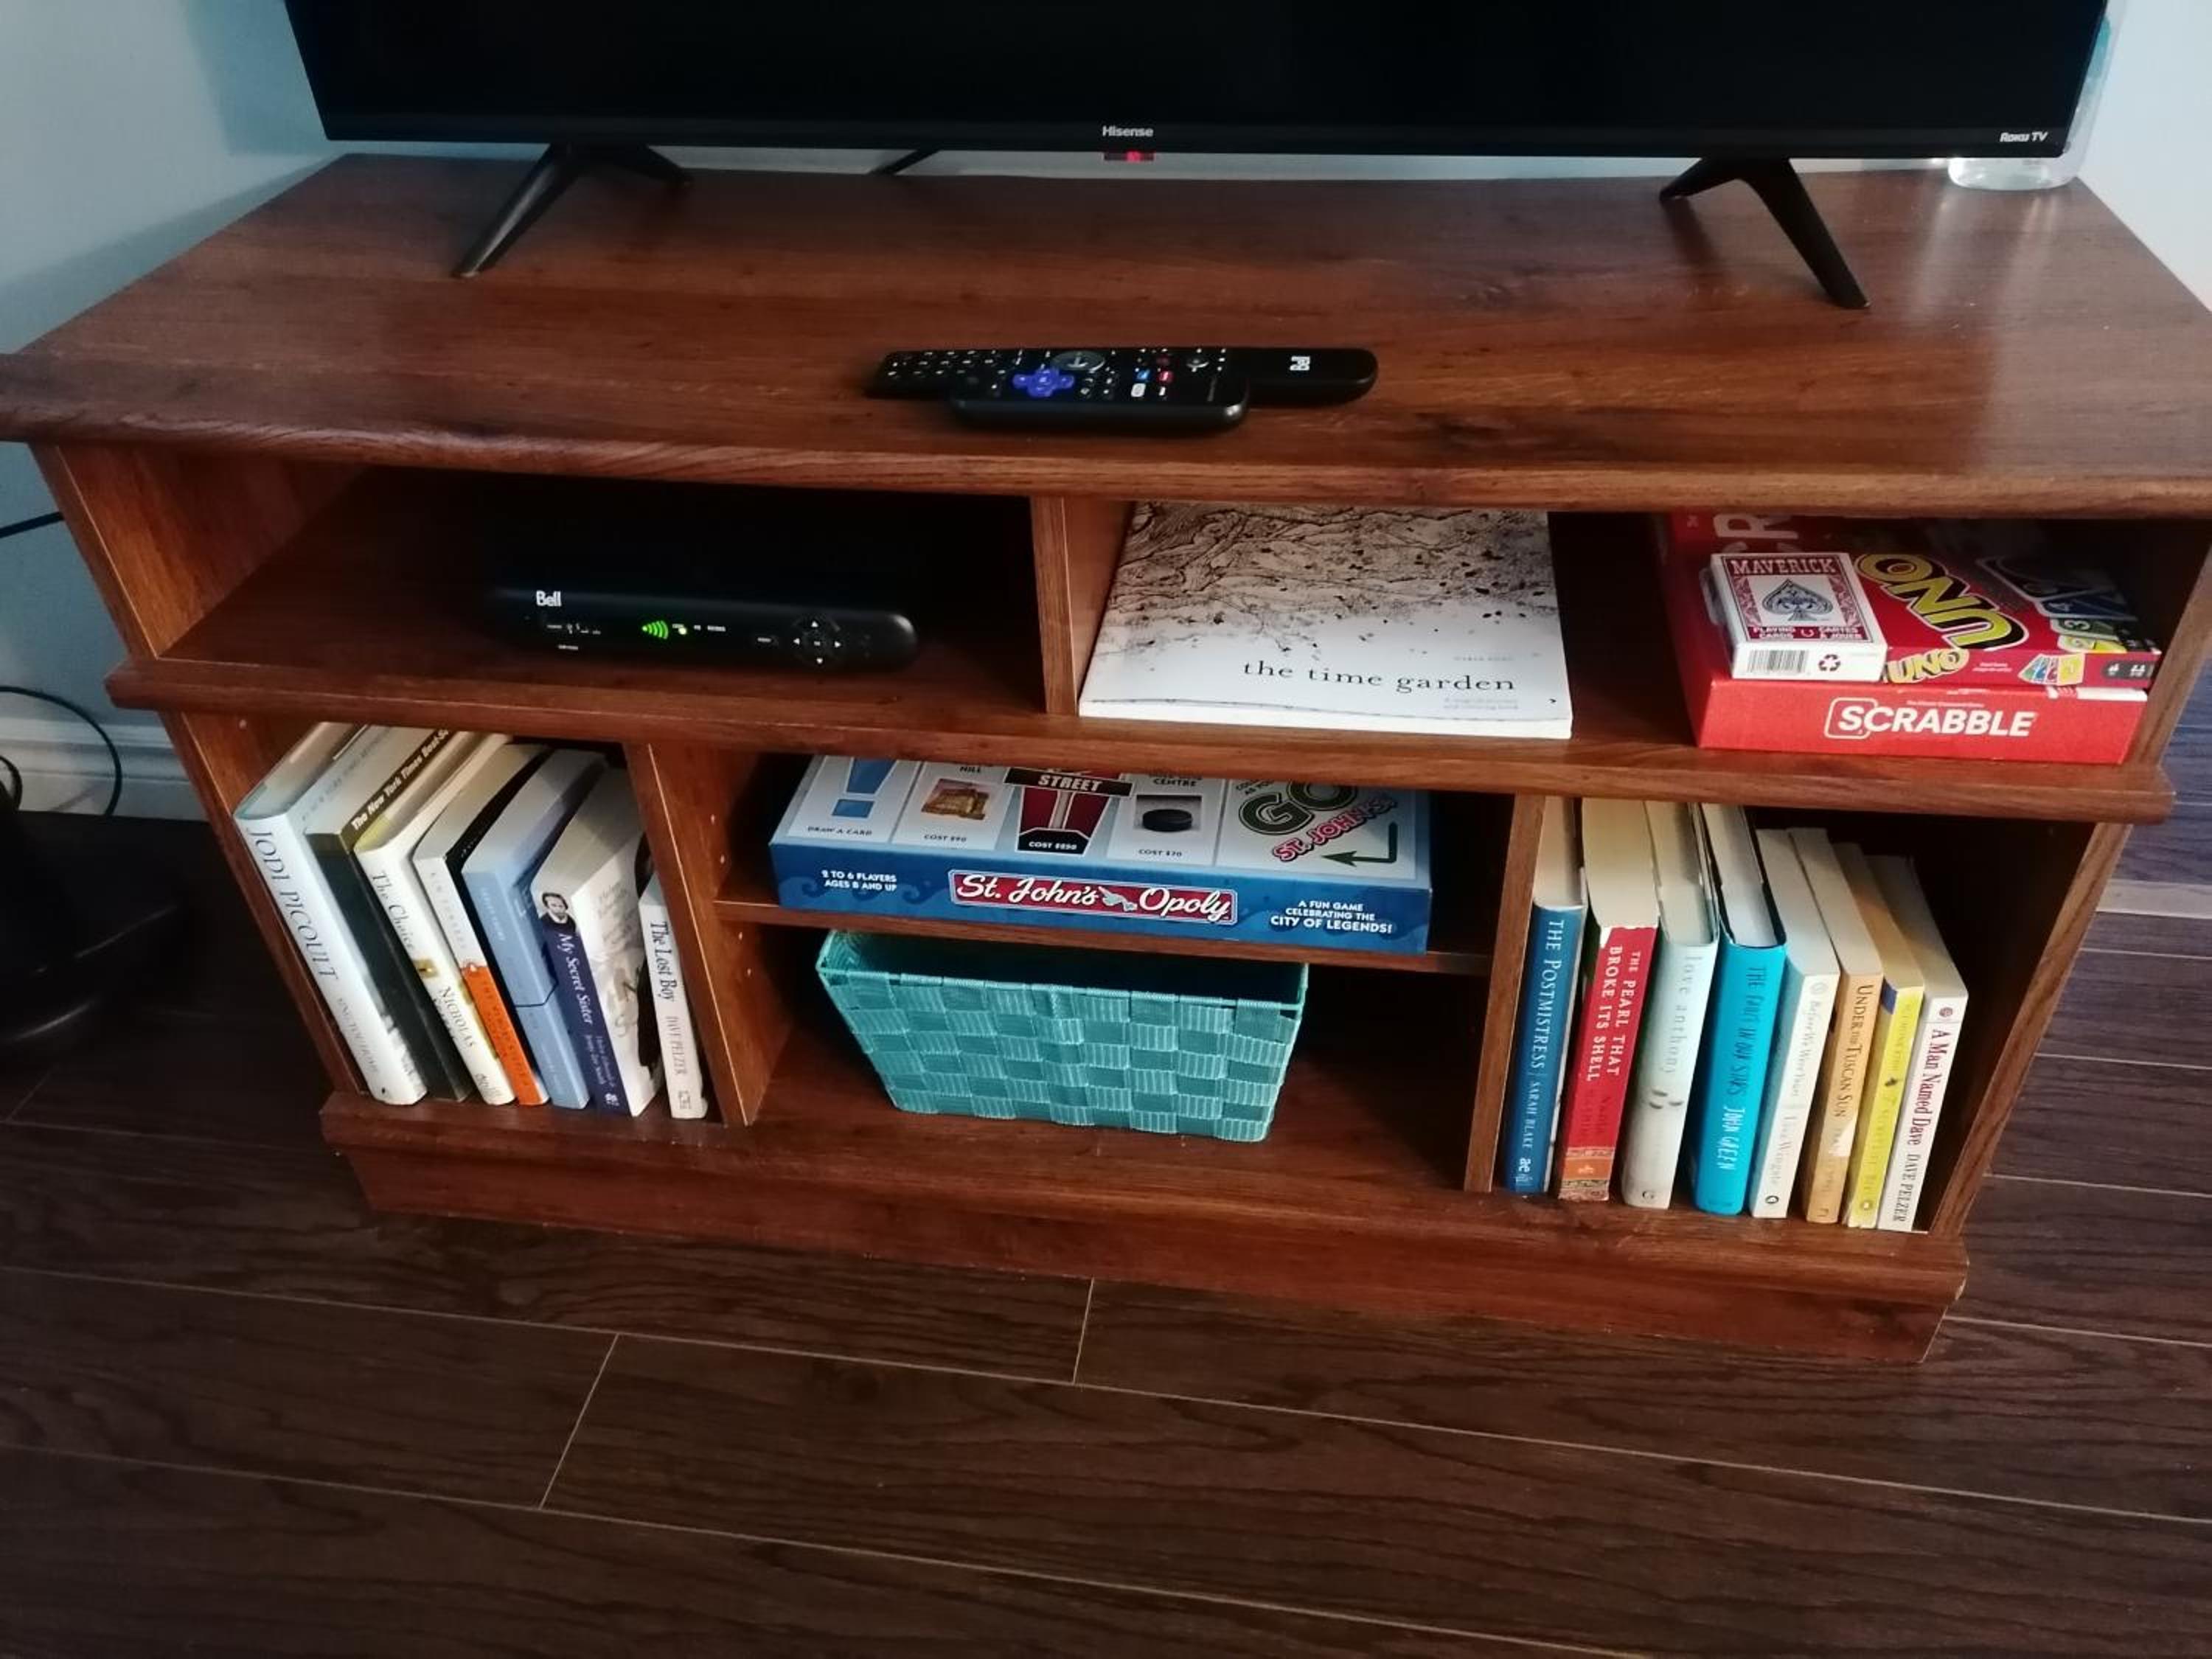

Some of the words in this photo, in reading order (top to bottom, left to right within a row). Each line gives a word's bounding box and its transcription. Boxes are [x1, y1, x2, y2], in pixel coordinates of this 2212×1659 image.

[1102, 125, 1154, 137] Hisense
[2031, 131, 2048, 142] TV
[1731, 558, 1836, 574] MAVERICK
[536, 591, 562, 607] Bell
[1854, 553, 2028, 651] UNO
[1244, 660, 1293, 678] the
[1309, 667, 1383, 686] time
[1396, 675, 1514, 694] garden
[1888, 649, 1969, 684] UNO
[1838, 706, 2037, 737] SCRABBLE
[351, 814, 368, 831] The
[367, 794, 385, 813] New
[384, 776, 403, 796] York
[400, 757, 423, 779] Times
[1037, 774, 1103, 792] STREET
[1153, 778, 1197, 787] CENTRE
[807, 826, 835, 834] DRAW
[923, 834, 947, 842] COST
[1029, 841, 1052, 849] COST
[824, 880, 849, 888] AGES
[861, 883, 883, 891] AND
[886, 883, 897, 891] UP
[830, 871, 844, 879] TO
[857, 872, 897, 883] PLAYERS
[246, 827, 290, 880] JODI
[279, 891, 339, 981] PICOULT
[372, 872, 391, 900] The
[388, 902, 414, 950] Choice
[957, 874, 1001, 899] St.
[1008, 877, 1099, 906] John's
[1139, 887, 1231, 922] Opoly
[1310, 900, 1330, 909] FUN
[1332, 902, 1363, 911] GAME
[1270, 915, 1300, 926] CITY
[1303, 918, 1322, 928] OF
[1327, 920, 1392, 933] LEGENDS!
[1285, 908, 1352, 920] CELEBRATING
[1356, 912, 1375, 921] THE
[558, 932, 575, 955] My
[650, 921, 669, 945] The
[1545, 919, 1565, 950] THE
[566, 956, 585, 992] Secret
[654, 948, 673, 976] Lost
[1601, 946, 1623, 998] BROKE
[1628, 951, 1641, 972] THE
[658, 979, 678, 1003] Boy
[1746, 966, 1767, 989] THE
[577, 992, 594, 1025] Sister
[1531, 959, 1562, 1068] POSTMISTRESS
[1596, 1005, 1613, 1029] ITS
[1615, 980, 1637, 1027] PEARL
[1851, 984, 1874, 1032] UNDER
[1932, 1029, 1951, 1040] A
[1586, 1036, 1607, 1082] SHELL
[1607, 1035, 1626, 1077] THAT
[1839, 1045, 1863, 1092] TUSCAN
[1923, 1043, 1948, 1070] Man
[1526, 1082, 1541, 1114] SARAH
[1834, 1095, 1853, 1118] SUN
[1914, 1072, 1944, 1115] Named
[1907, 1116, 1931, 1146] Dave
[1902, 1152, 1920, 1180] DAVE
[1892, 1182, 1914, 1222] PELZER
